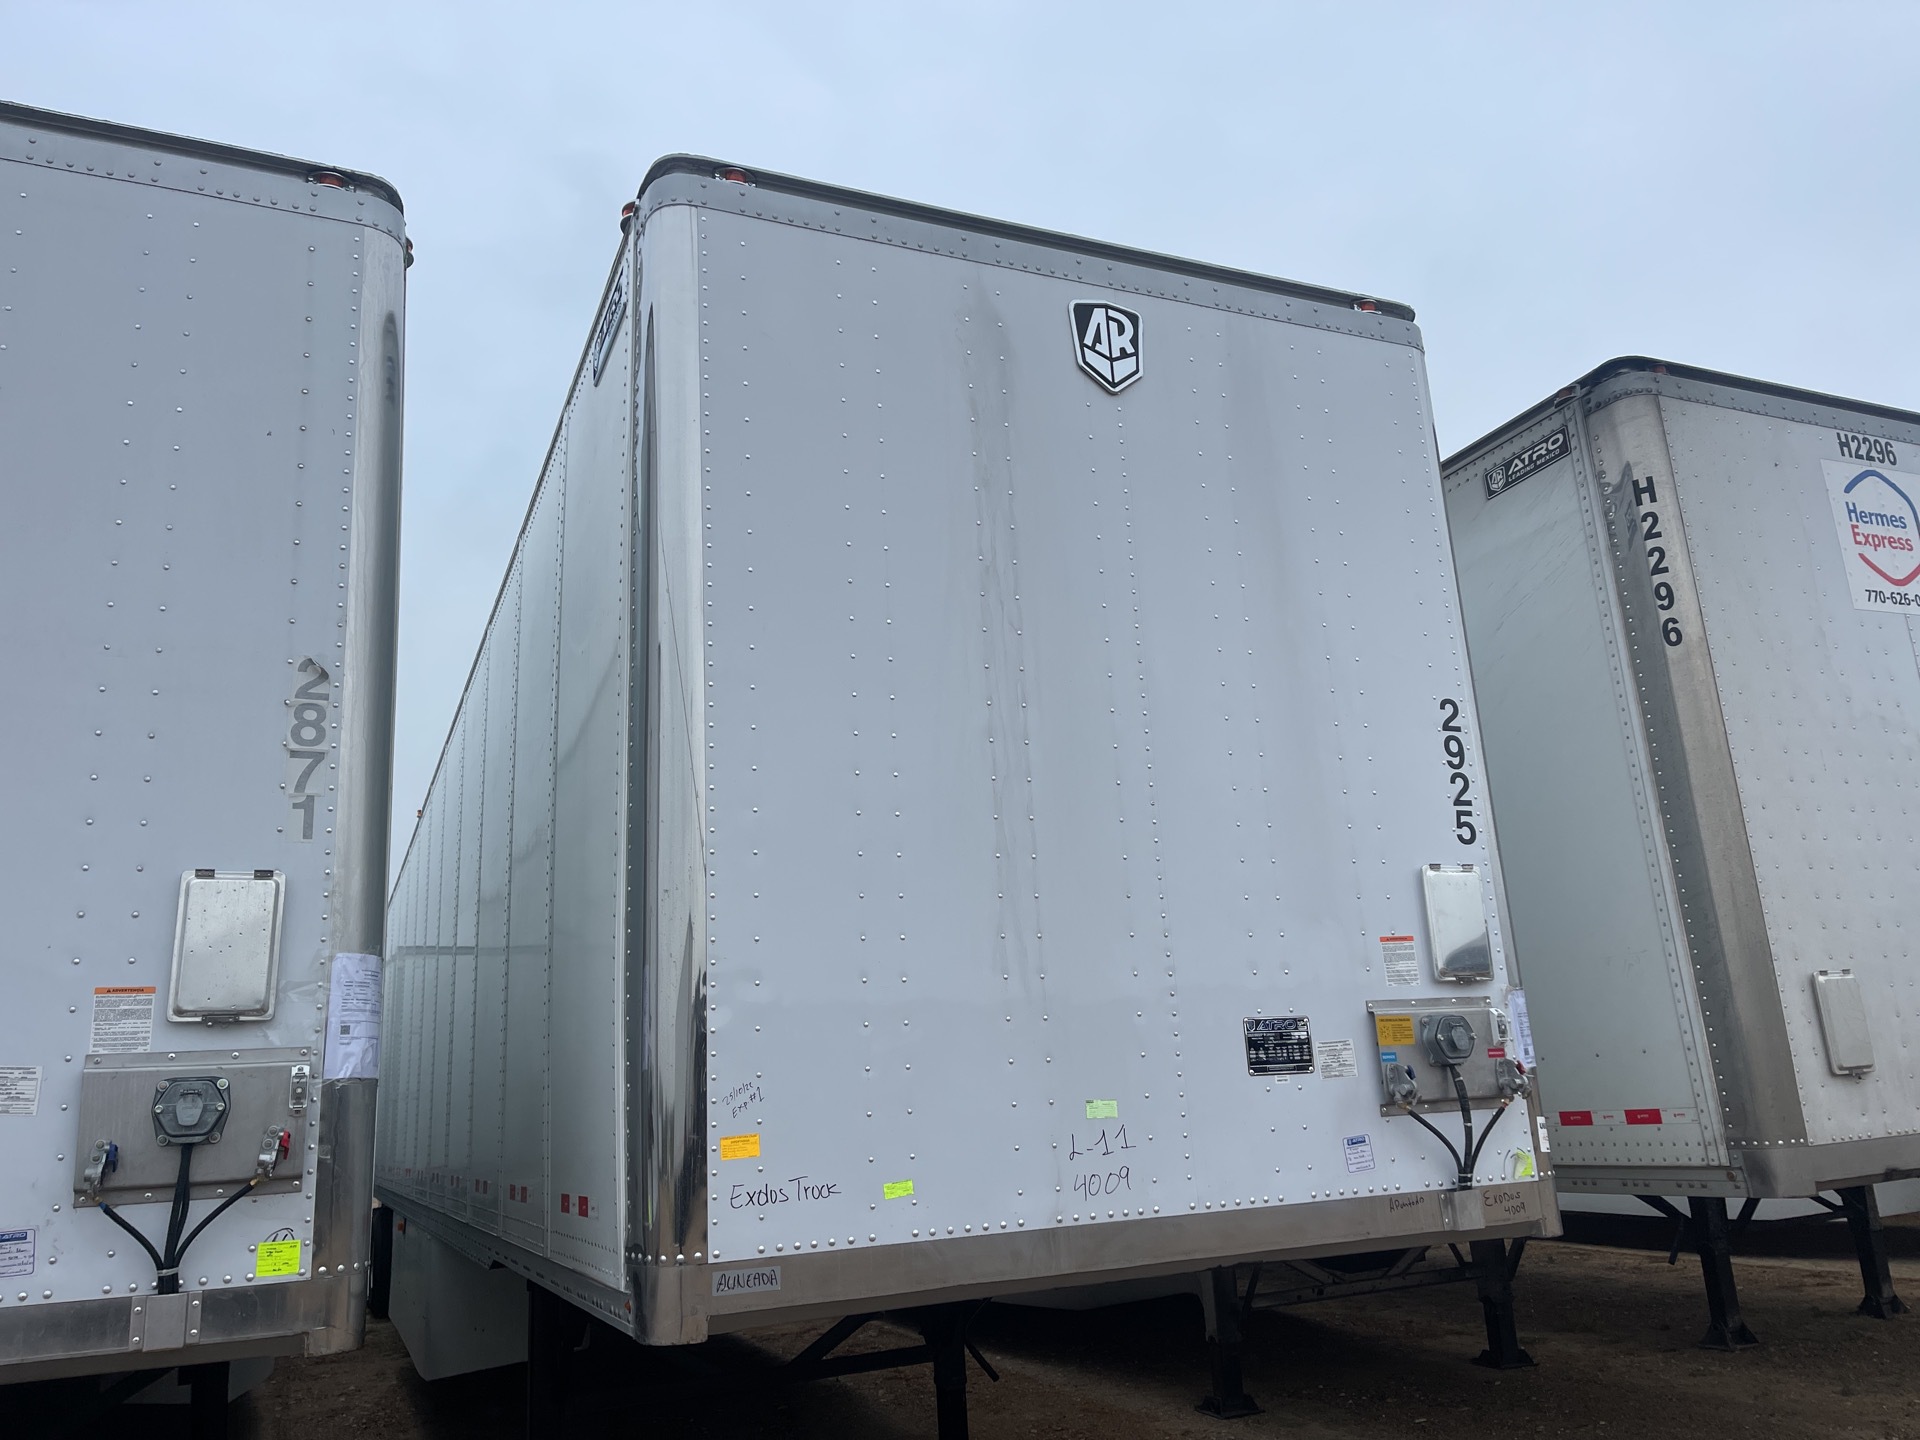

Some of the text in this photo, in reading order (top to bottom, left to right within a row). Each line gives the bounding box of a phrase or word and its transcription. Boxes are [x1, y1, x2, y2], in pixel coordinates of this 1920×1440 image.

[1507, 433, 1564, 476] ATRO
[1508, 448, 1560, 482] LEADING MEXICO
[1836, 432, 1898, 466] H2296
[1845, 501, 1907, 530] Hermes
[1850, 524, 1914, 552] Express
[1632, 475, 1683, 647] H2296
[289, 657, 330, 840] 2871
[1439, 698, 1477, 846] 2925
[1256, 1019, 1297, 1031] ATRO
[1073, 1165, 1132, 1202] 4009
